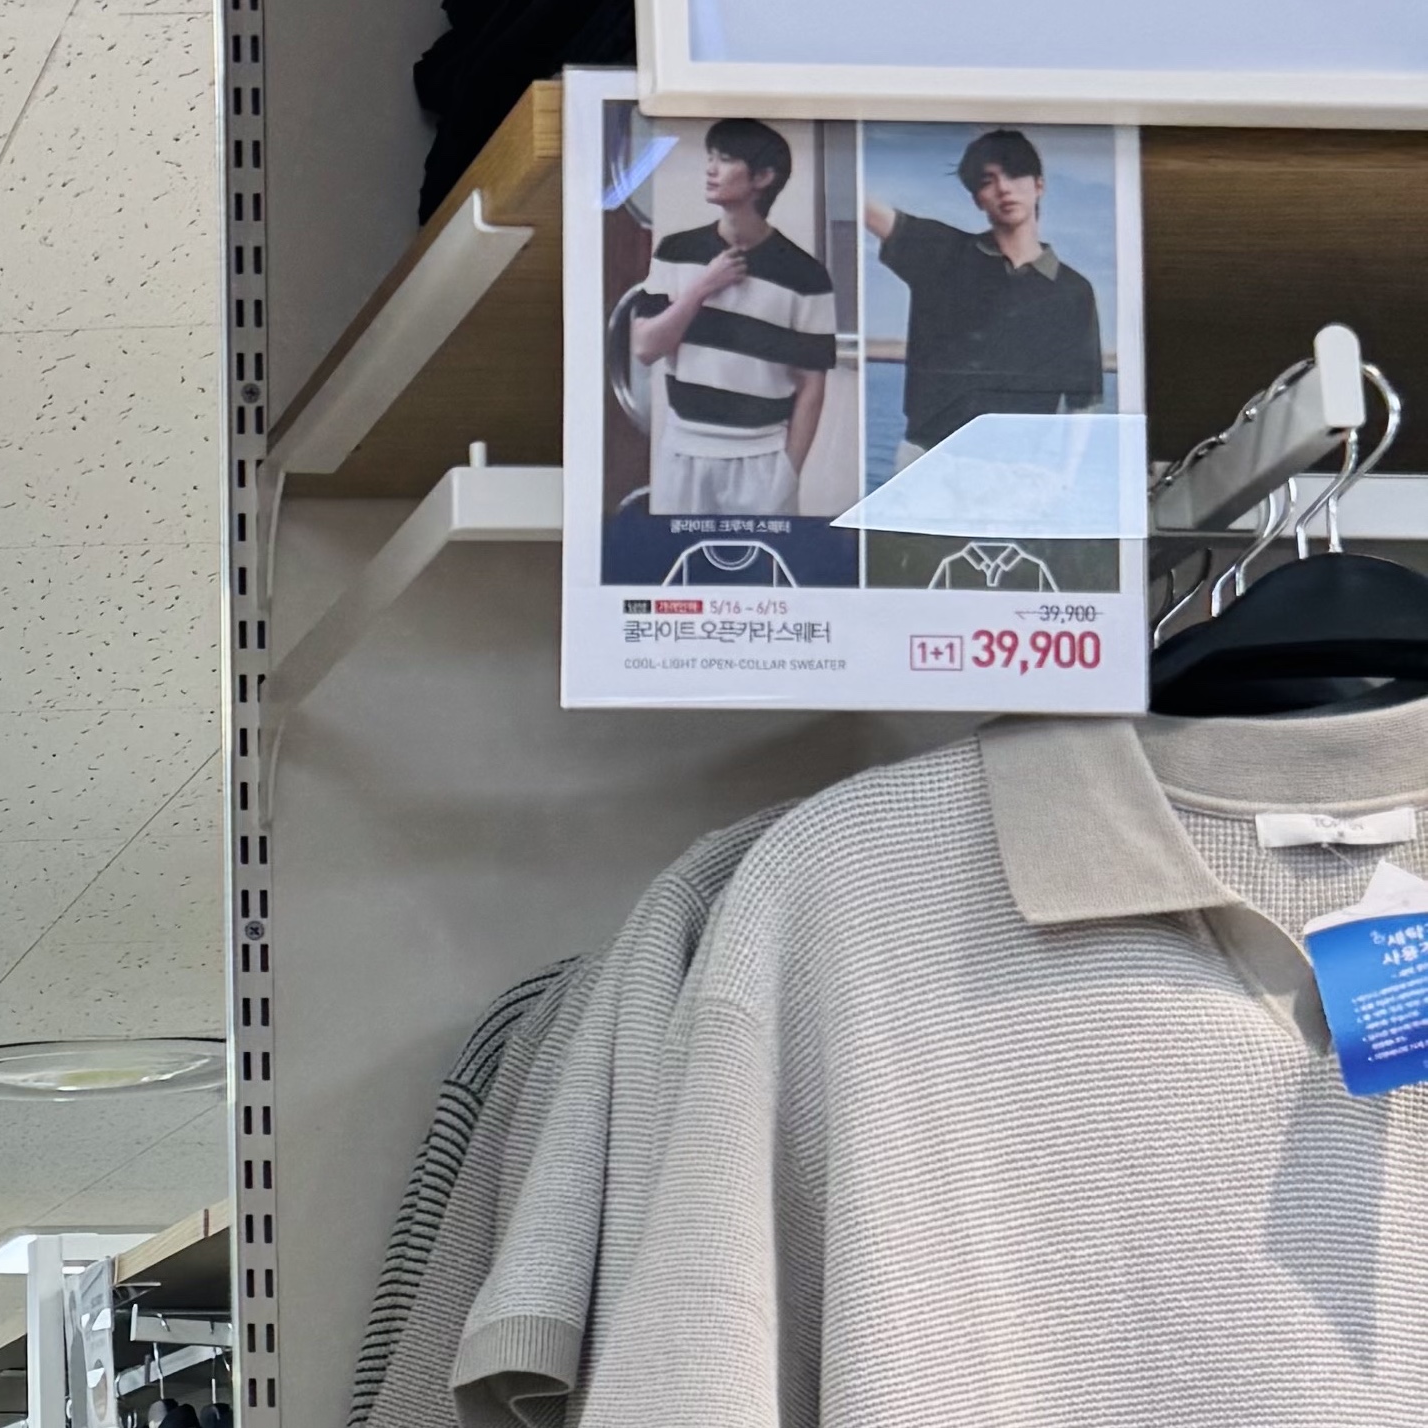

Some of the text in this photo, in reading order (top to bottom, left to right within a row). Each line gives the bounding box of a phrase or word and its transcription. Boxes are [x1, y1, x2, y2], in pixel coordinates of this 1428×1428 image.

[710, 601, 741, 615] 5/16
[757, 601, 788, 615] 6/15
[1038, 605, 1096, 623] 39,900
[623, 619, 831, 644] 쿨라이트 오픈카라 스웨터
[917, 629, 1102, 676] 1+1 39,900
[623, 657, 847, 671] COOL-LIGHT OPEN-COLLAR SWEATER
